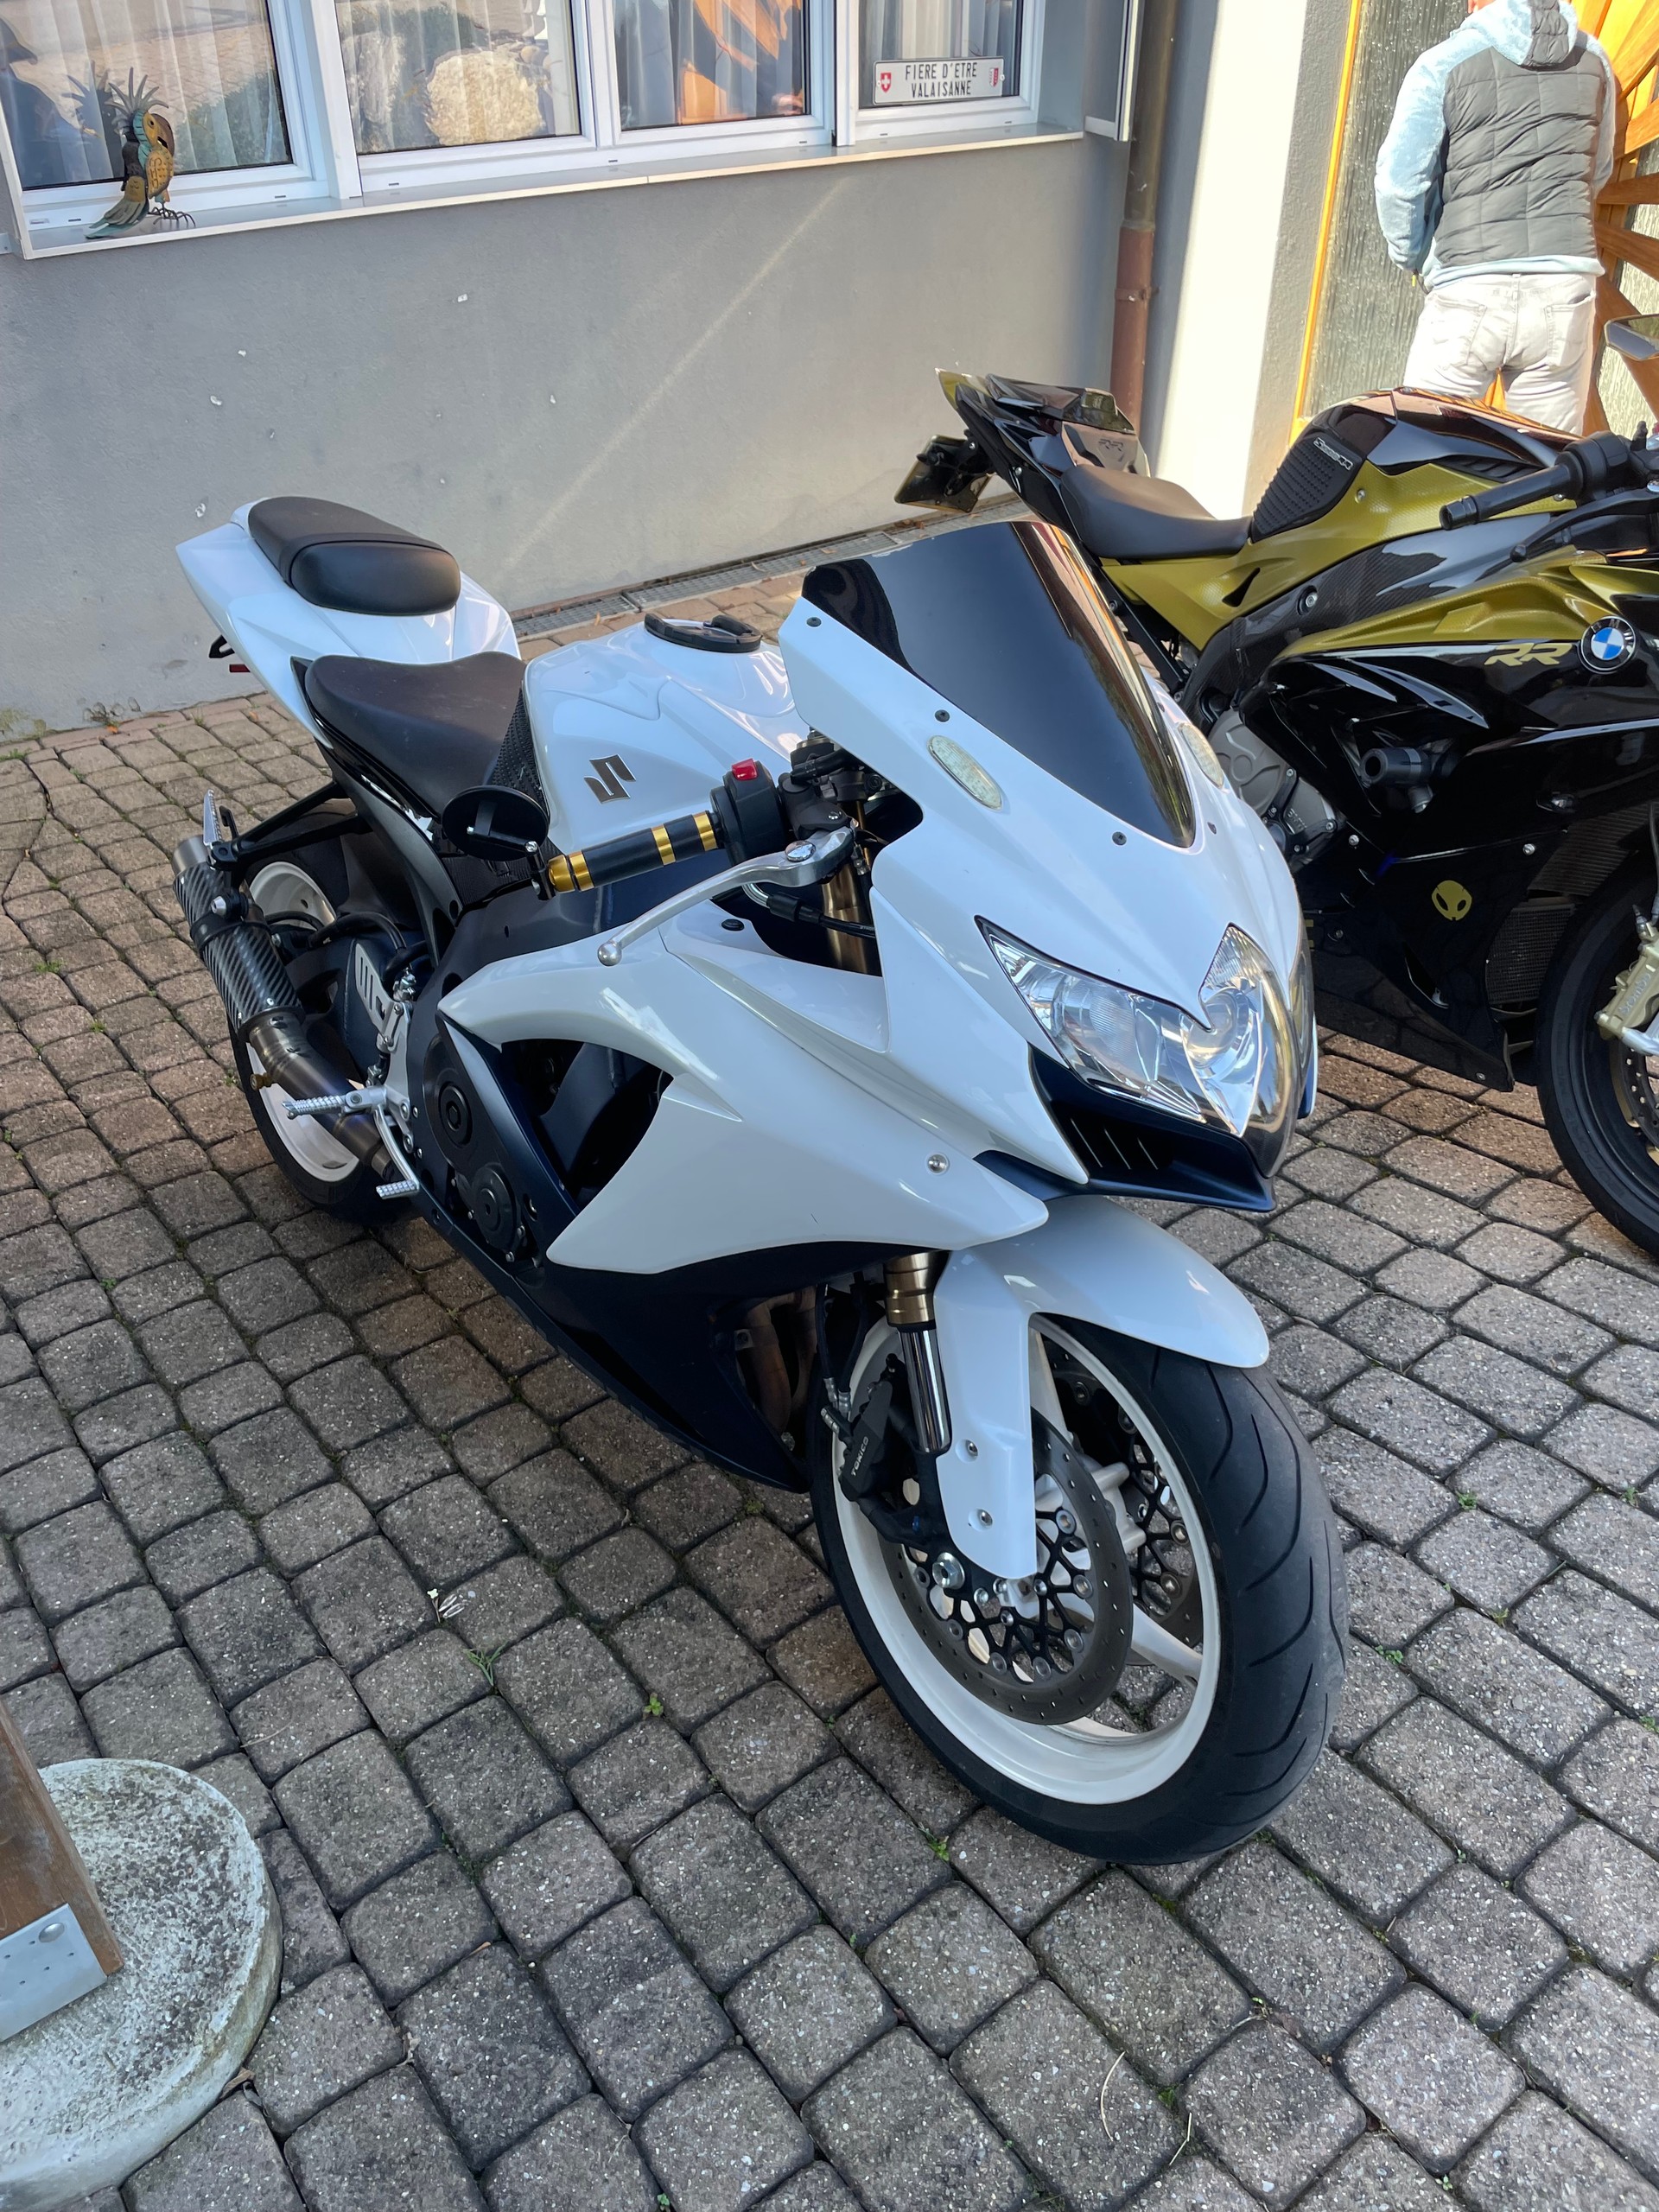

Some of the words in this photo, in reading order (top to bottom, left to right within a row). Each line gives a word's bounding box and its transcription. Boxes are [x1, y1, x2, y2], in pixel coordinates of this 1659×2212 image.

[906, 64, 937, 79] FIERE
[942, 62, 977, 79] D'ETRE
[912, 80, 971, 98] VALAISANNE
[1590, 618, 1633, 646] BMW
[1484, 642, 1573, 667] RR
[850, 1436, 869, 1477] TOKICO
